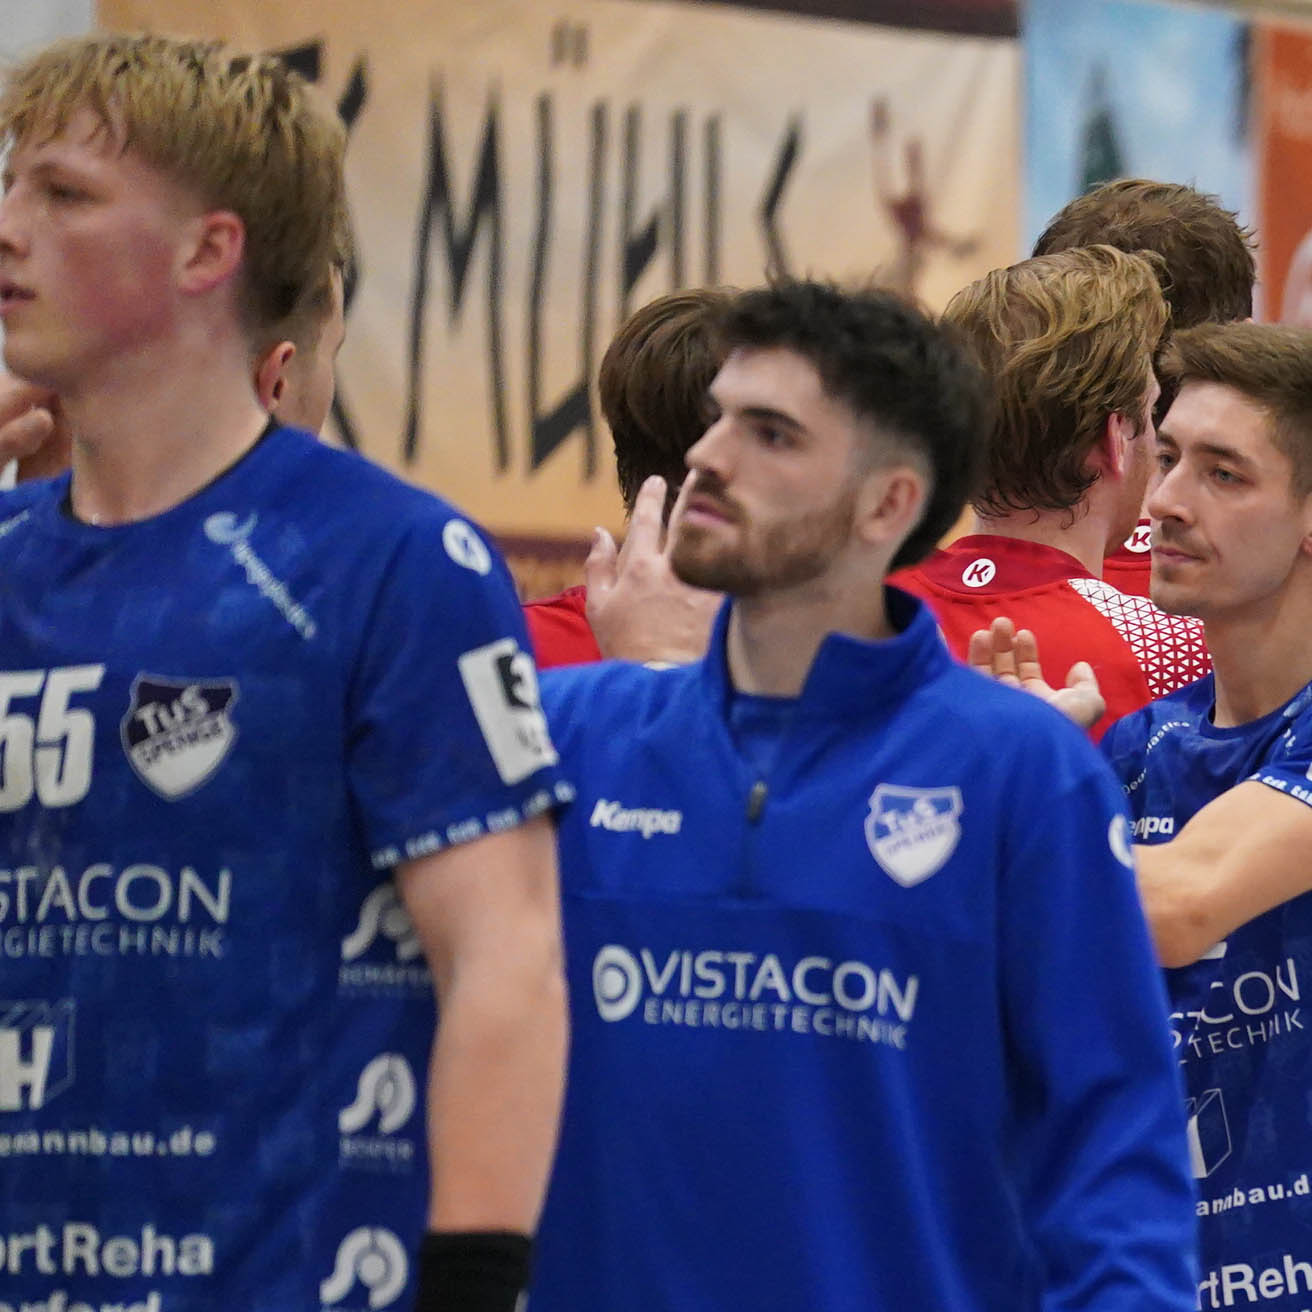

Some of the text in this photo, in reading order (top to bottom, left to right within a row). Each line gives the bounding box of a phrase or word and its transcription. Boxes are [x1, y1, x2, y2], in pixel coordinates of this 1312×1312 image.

[0, 663, 107, 813] 55
[590, 798, 683, 840] Kempa
[639, 947, 919, 1022] VISTACON
[0, 1222, 215, 1277] rtReha
